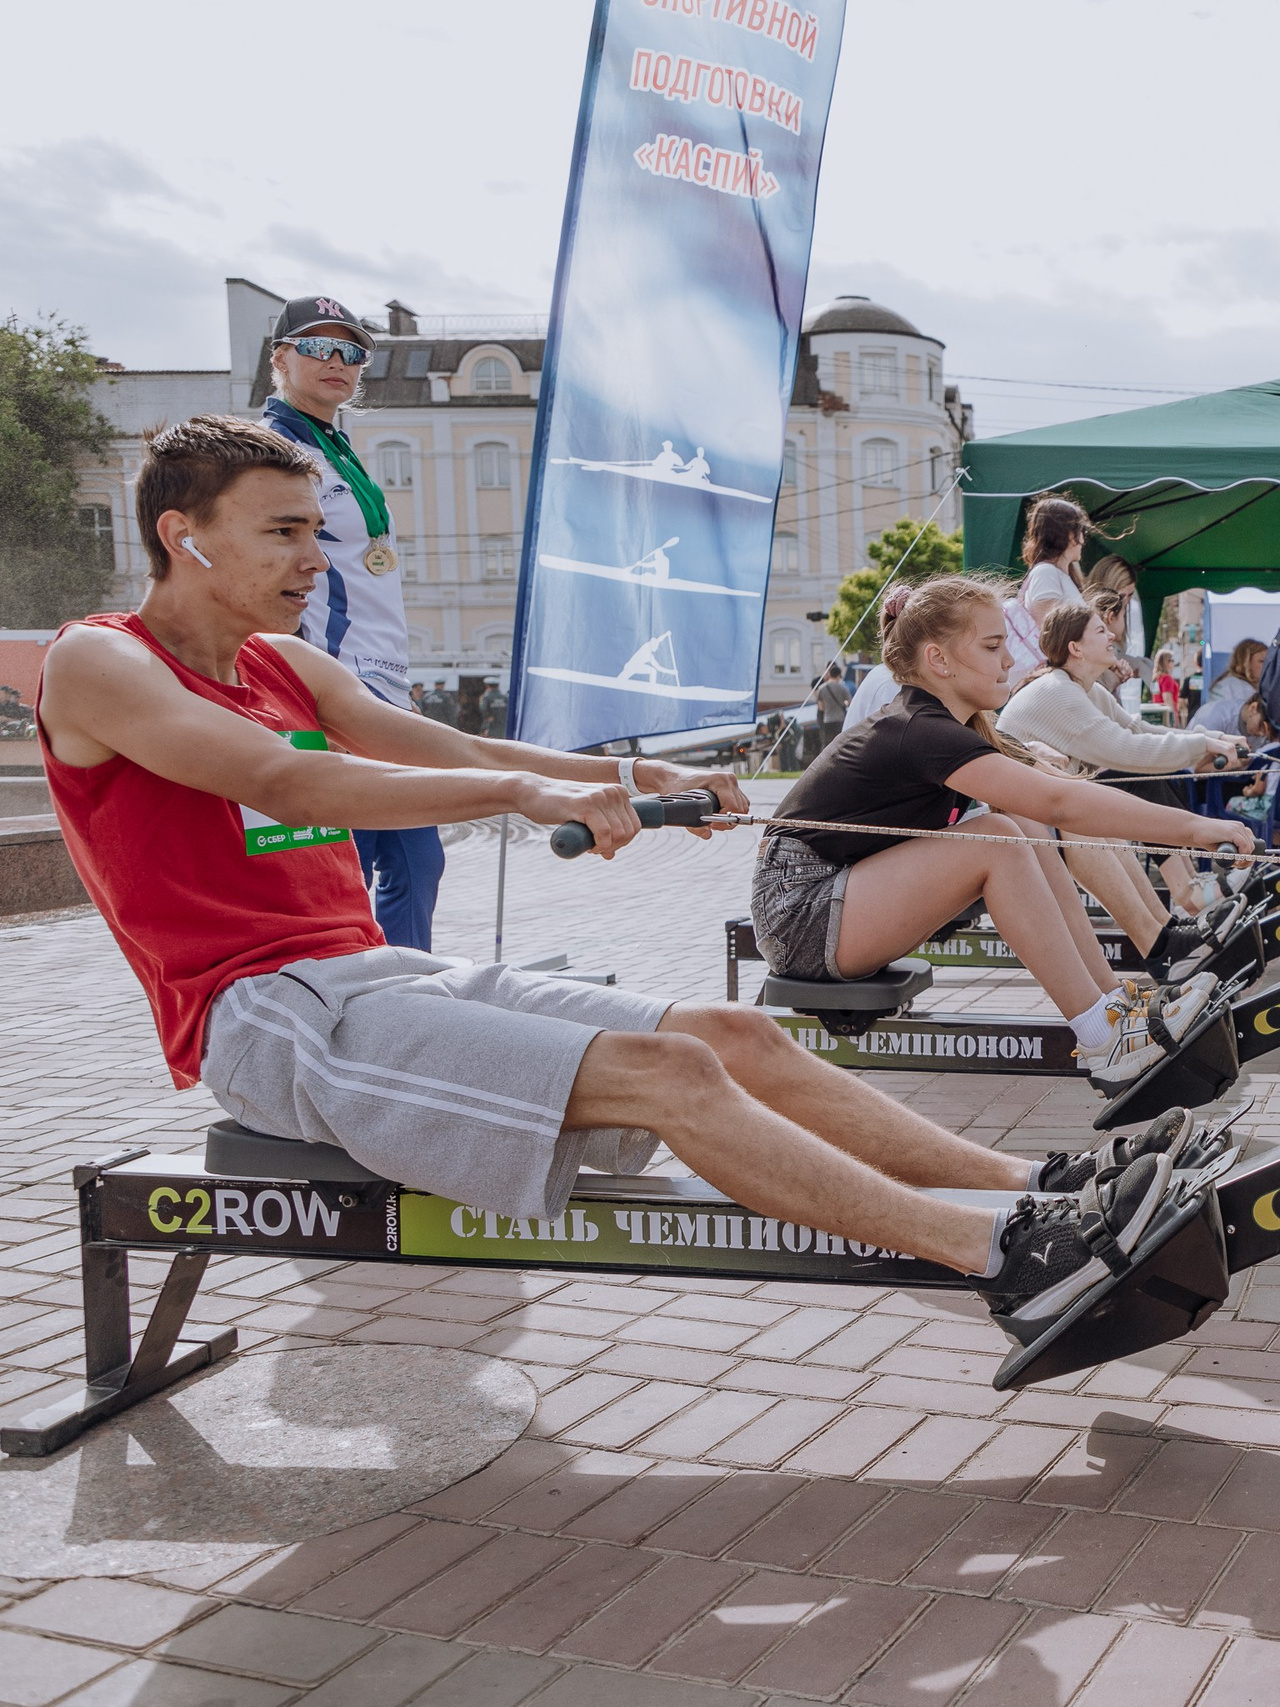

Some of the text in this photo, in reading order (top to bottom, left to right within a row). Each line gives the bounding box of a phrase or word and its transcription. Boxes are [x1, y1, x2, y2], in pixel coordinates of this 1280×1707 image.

[632, 52, 802, 131] ПОДГОТОВКИ
[637, 136, 777, 198] «КАСПИЙ»
[315, 297, 345, 319] NY
[267, 834, 287, 844] СБЕР
[917, 938, 973, 957] ТАНЬ
[849, 1031, 1043, 1060] ЧЕМПИОНОМ
[147, 1186, 340, 1238] C2ROW
[385, 1186, 398, 1252] C2ROW.k
[449, 1206, 599, 1242] СТАНЬ
